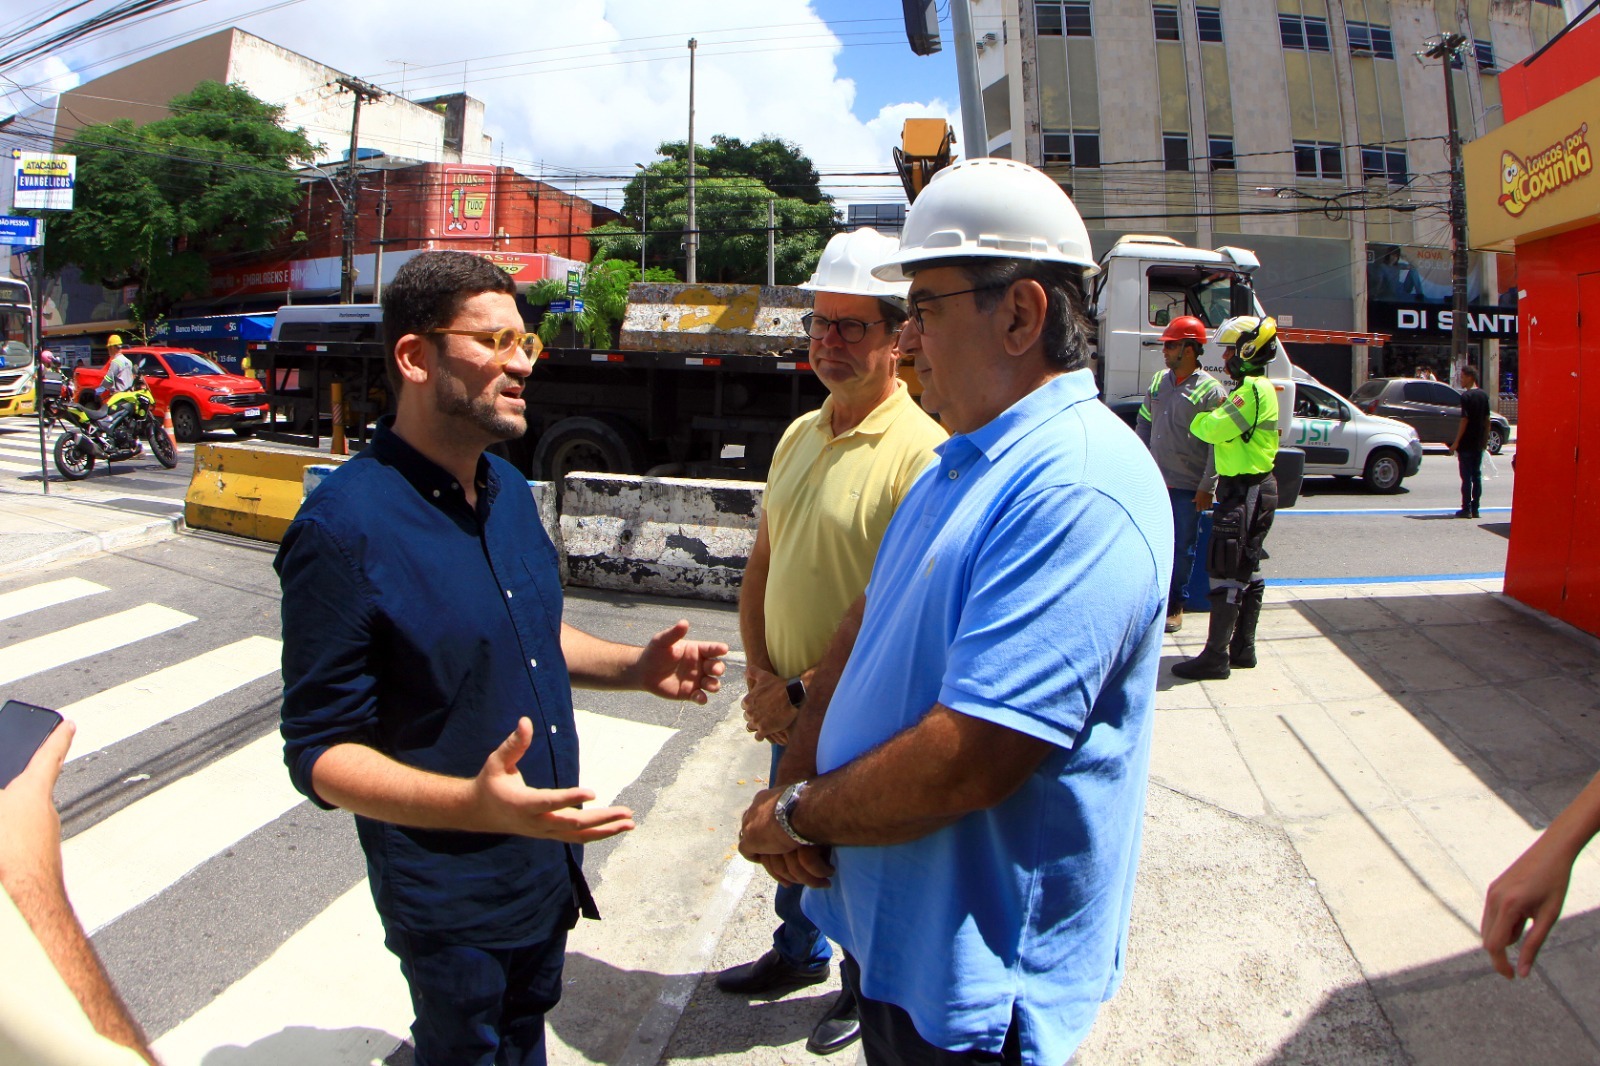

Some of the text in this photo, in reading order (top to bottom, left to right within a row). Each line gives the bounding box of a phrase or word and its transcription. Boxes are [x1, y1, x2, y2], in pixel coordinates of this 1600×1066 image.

[1526, 131, 1584, 175] Loucos por
[453, 173, 478, 187] LOJAS
[1518, 145, 1592, 203] Coxinha
[467, 200, 484, 211] TUDO
[9, 218, 30, 227] PESSOA
[1416, 250, 1444, 260] NOVA
[242, 270, 284, 287] EMBALAGENS
[283, 269, 289, 282] E
[1397, 309, 1428, 330] DI
[1295, 420, 1332, 445] JST
